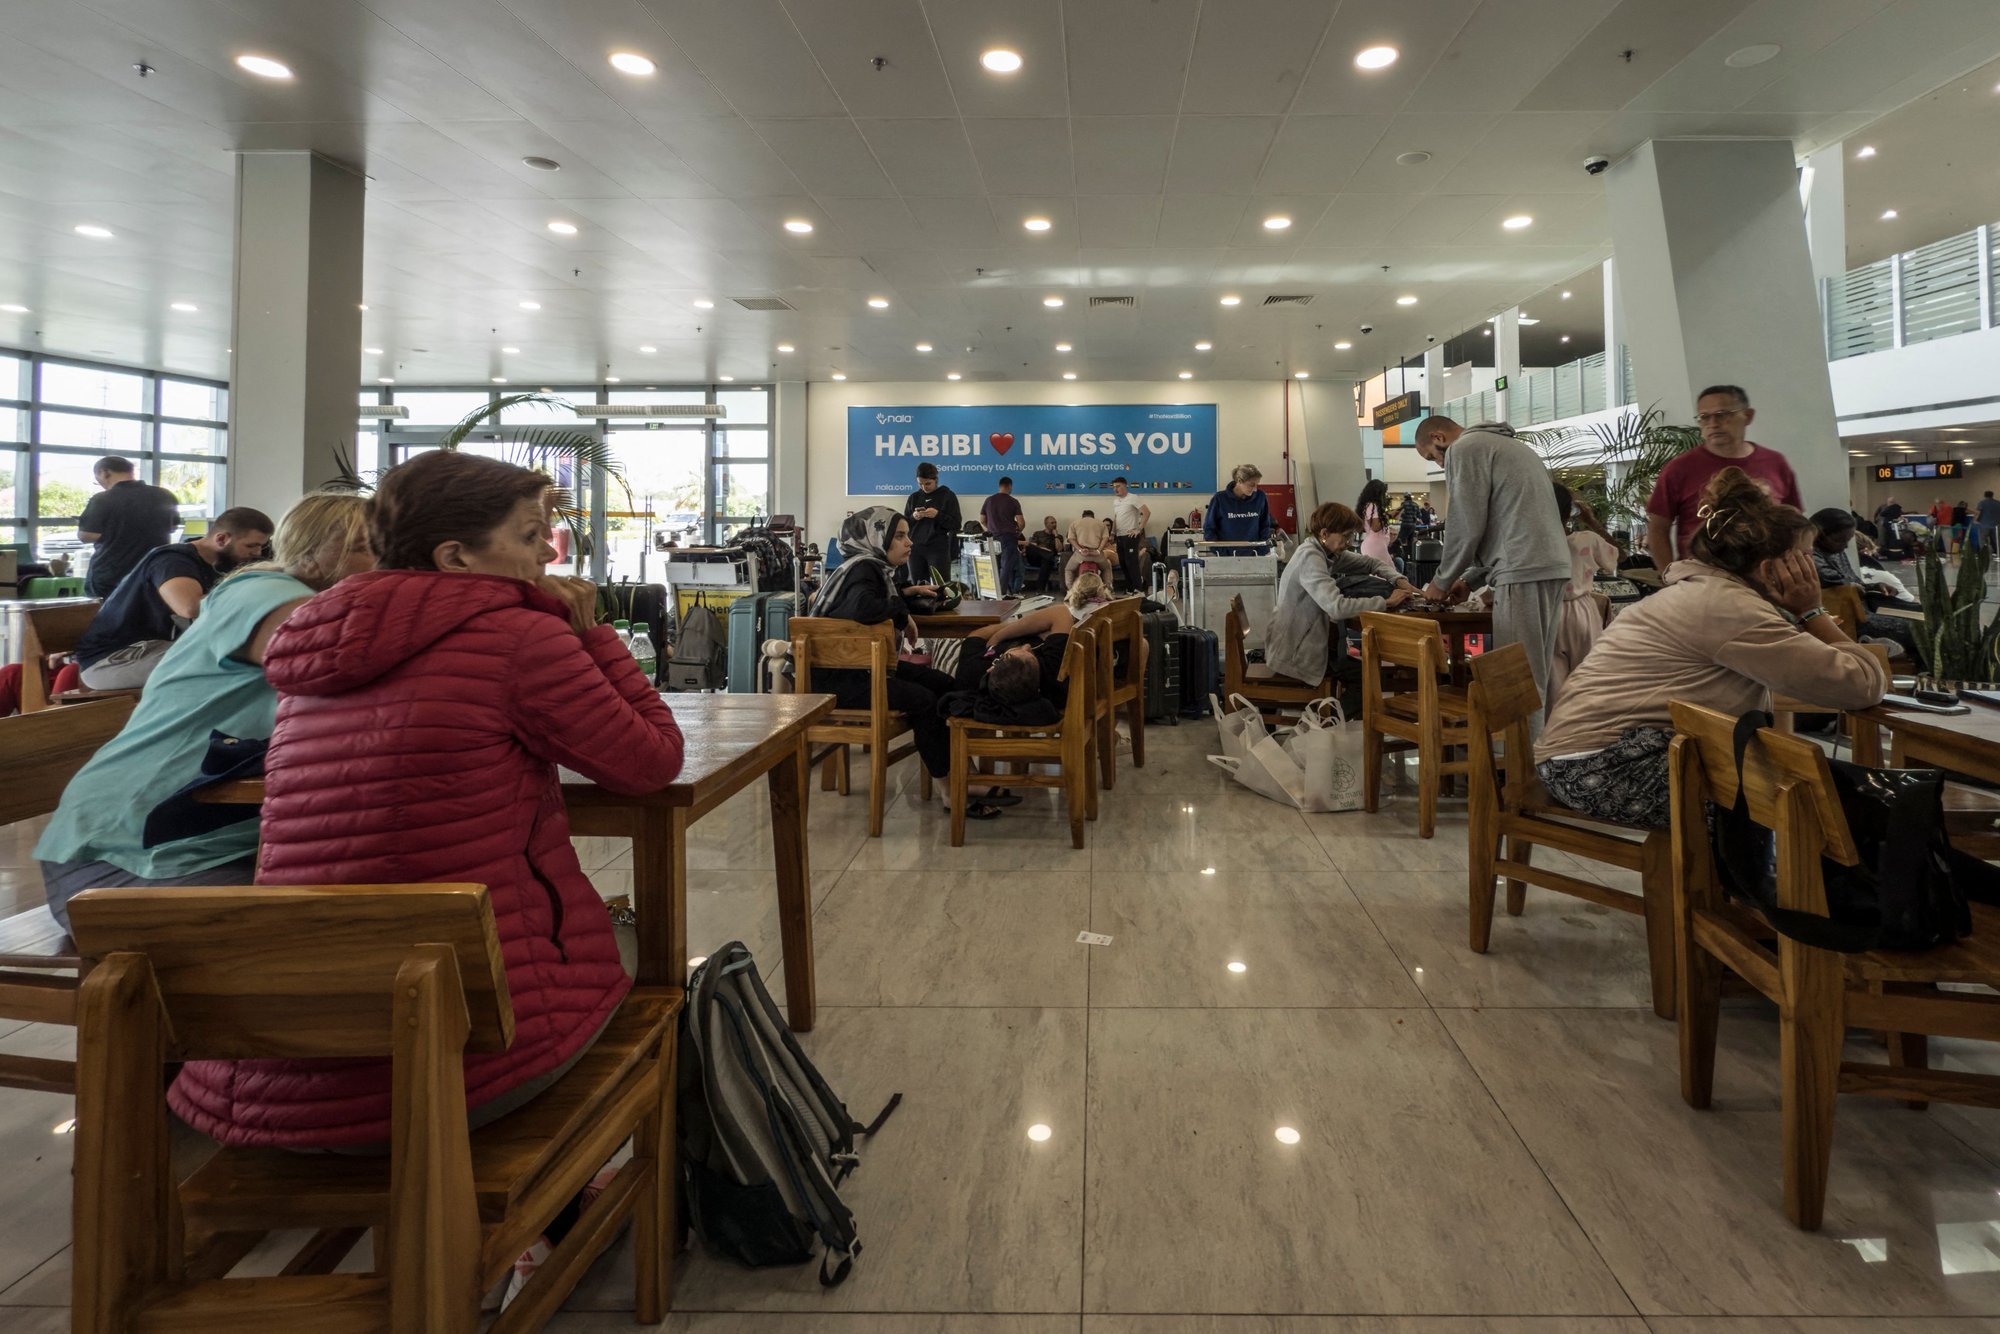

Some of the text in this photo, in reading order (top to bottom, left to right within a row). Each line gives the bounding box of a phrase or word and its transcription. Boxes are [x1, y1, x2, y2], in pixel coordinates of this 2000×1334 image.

[887, 414, 912, 423] nala
[875, 432, 1192, 457] HABIBI I MISS YOU
[936, 462, 1125, 474] Send money to Africa with amazing rates
[1878, 464, 1954, 478] 06 07
